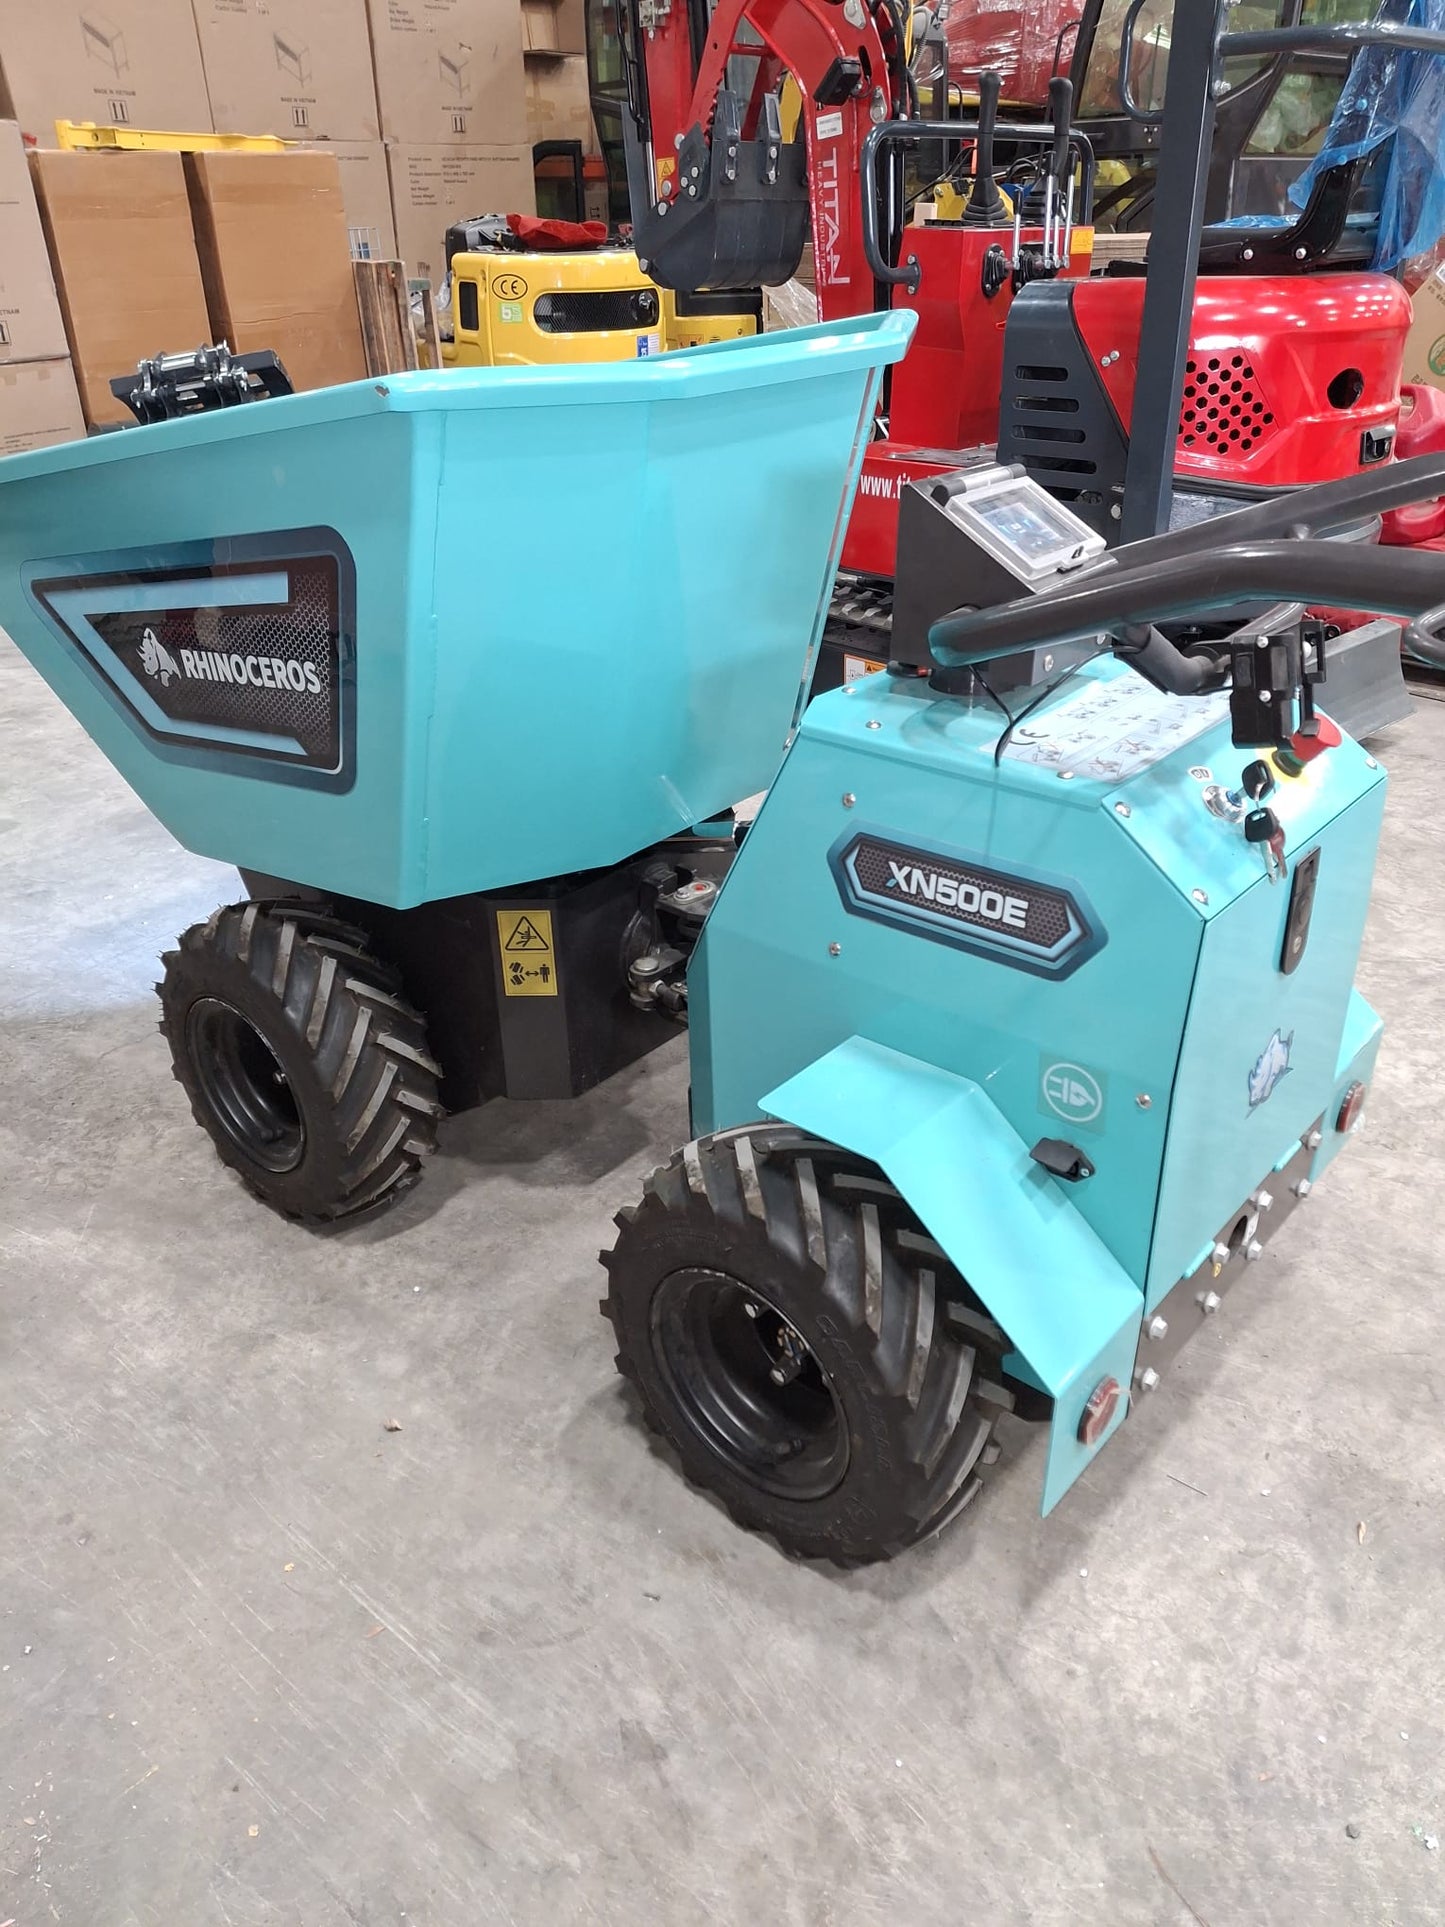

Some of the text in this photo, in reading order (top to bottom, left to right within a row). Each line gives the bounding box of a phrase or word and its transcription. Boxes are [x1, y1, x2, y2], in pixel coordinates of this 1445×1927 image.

[816, 161, 824, 206] HEAVY
[823, 147, 850, 284] TITAN
[500, 279, 519, 296] CE
[180, 649, 321, 694] RHINOCEROS
[885, 860, 1029, 929] XN500E
